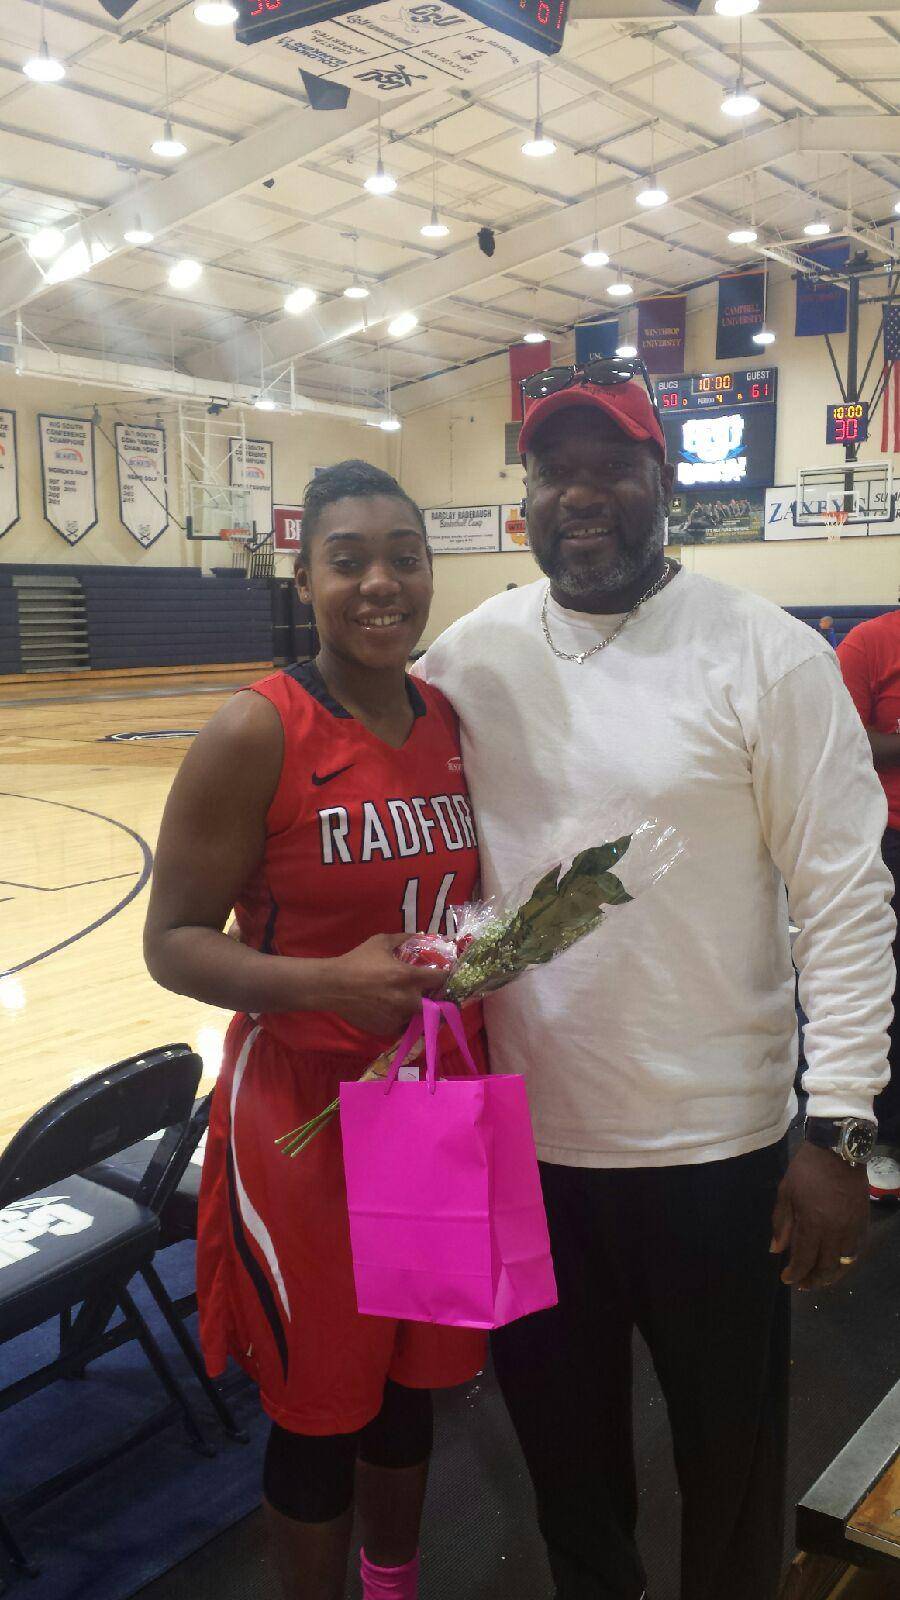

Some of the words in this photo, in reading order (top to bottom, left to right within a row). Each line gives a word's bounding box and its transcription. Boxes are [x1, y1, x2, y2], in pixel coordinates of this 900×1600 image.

[644, 328, 680, 337] WINTHROP
[642, 338, 681, 348] UNIVERSITY
[658, 380, 679, 390] BUCS
[698, 375, 731, 391] 10:00
[746, 370, 770, 381] GUEST
[751, 384, 769, 398] 61
[833, 404, 863, 419] 10:00
[835, 418, 858, 440] 30
